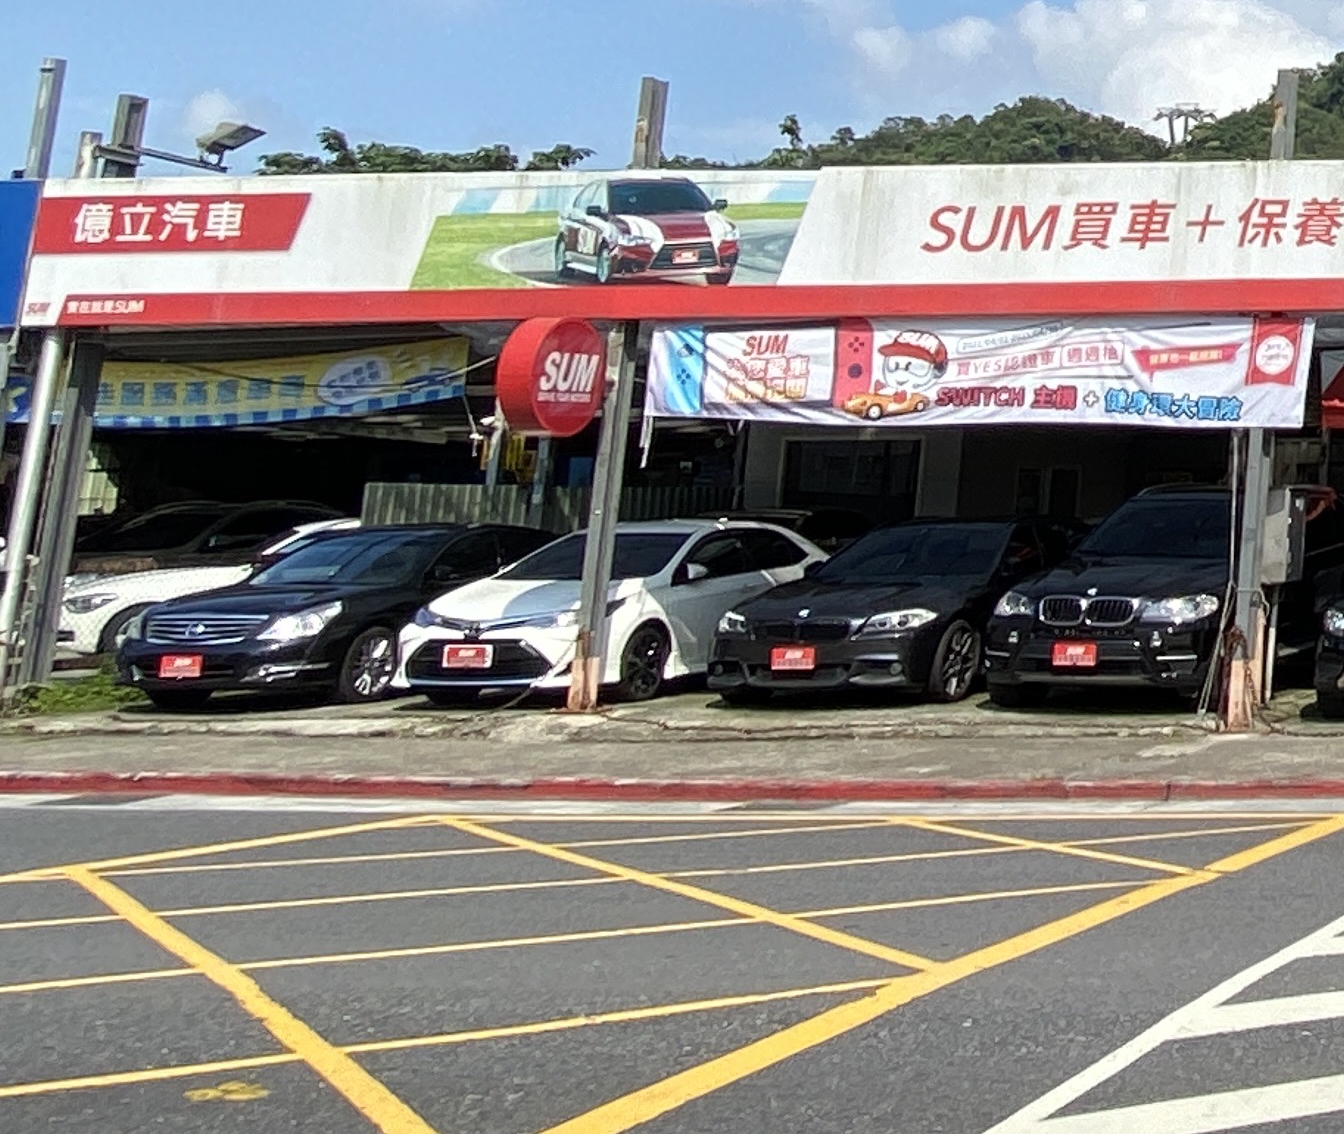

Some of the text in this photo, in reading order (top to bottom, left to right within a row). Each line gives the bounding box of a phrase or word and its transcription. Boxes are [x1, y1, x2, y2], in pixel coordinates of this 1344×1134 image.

[73, 199, 246, 244] 億立汽車
[742, 334, 788, 356] SUM
[539, 351, 600, 392] SUM
[934, 386, 1025, 407] SWITCH
[1031, 385, 1077, 410] 主機
